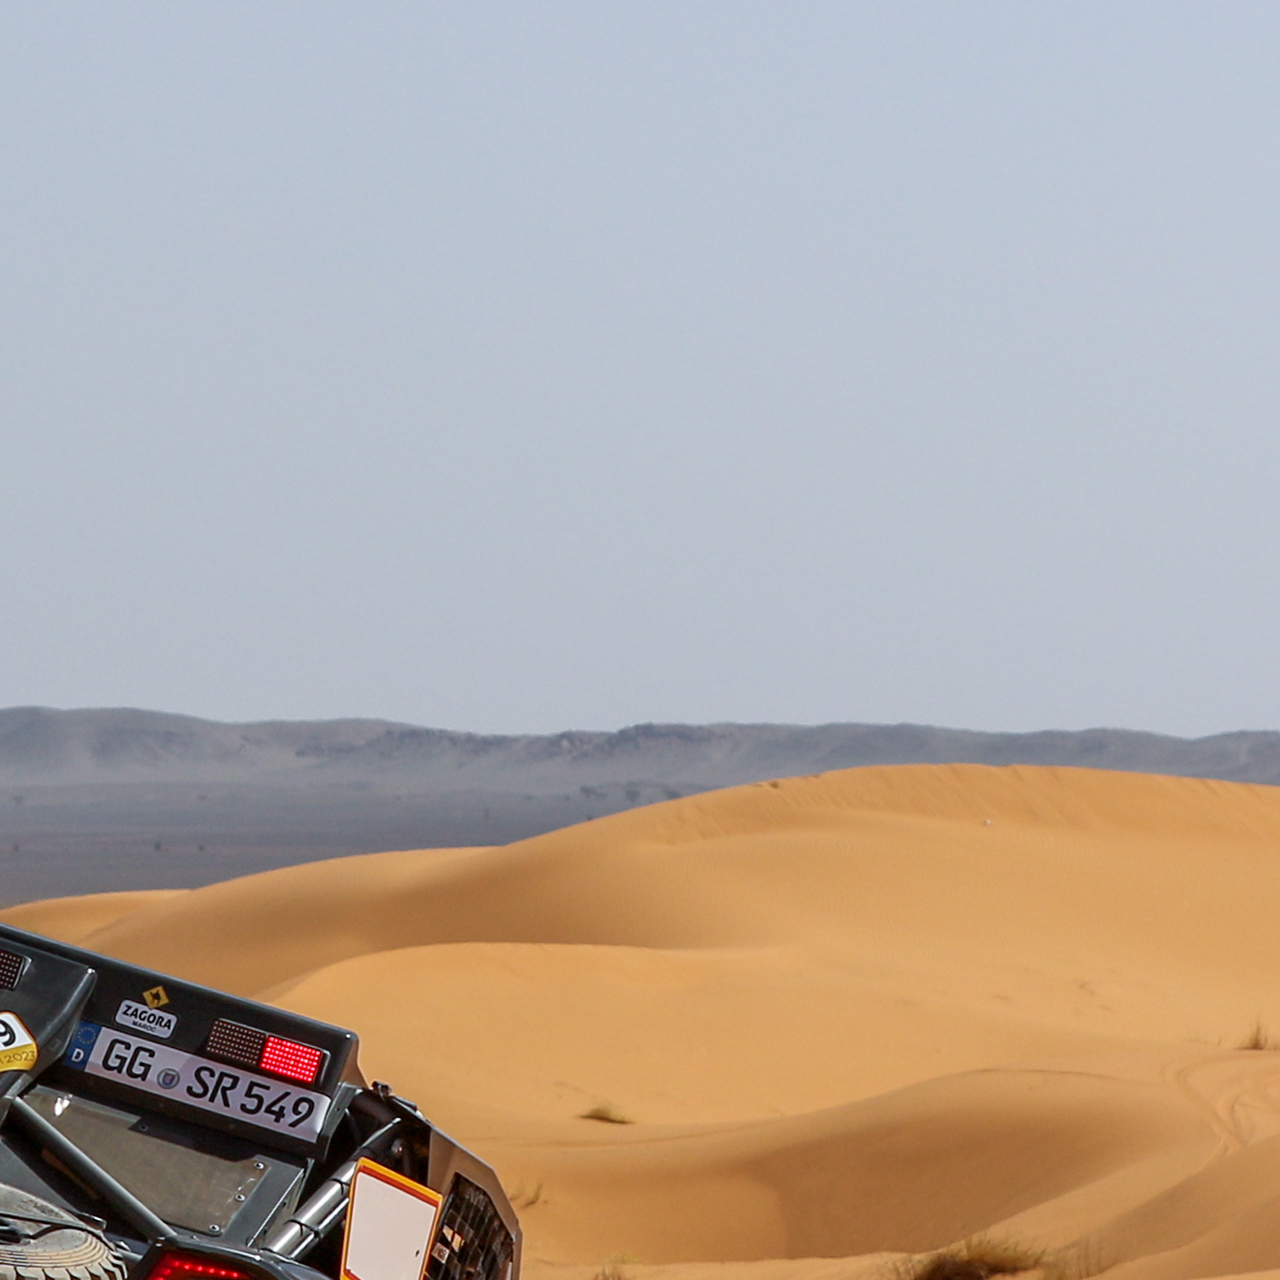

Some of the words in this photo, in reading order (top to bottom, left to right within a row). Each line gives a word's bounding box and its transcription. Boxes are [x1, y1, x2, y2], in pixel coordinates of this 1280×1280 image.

[122, 1004, 172, 1030] ZAGORA
[132, 1020, 157, 1033] MAROC
[6, 1050, 36, 1065] 2023
[71, 1048, 85, 1062] D
[101, 1038, 155, 1082] GG
[186, 1065, 239, 1108] SR
[239, 1080, 315, 1129] 549
